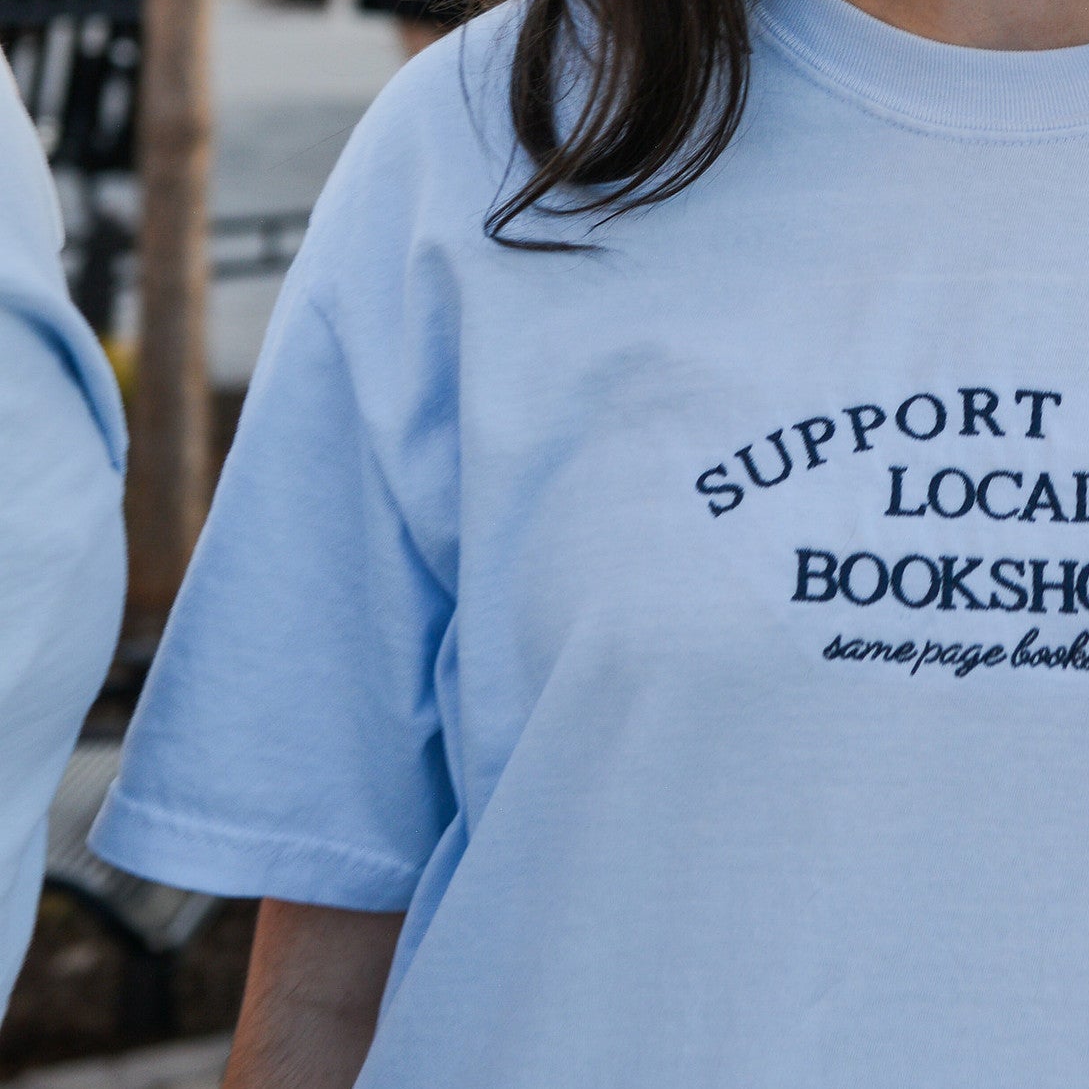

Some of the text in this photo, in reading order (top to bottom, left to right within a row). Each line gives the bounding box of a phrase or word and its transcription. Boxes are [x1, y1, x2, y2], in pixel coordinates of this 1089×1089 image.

[695, 387, 1062, 518] SUPPORT
[822, 634, 918, 664] same
[911, 639, 1007, 679] page
